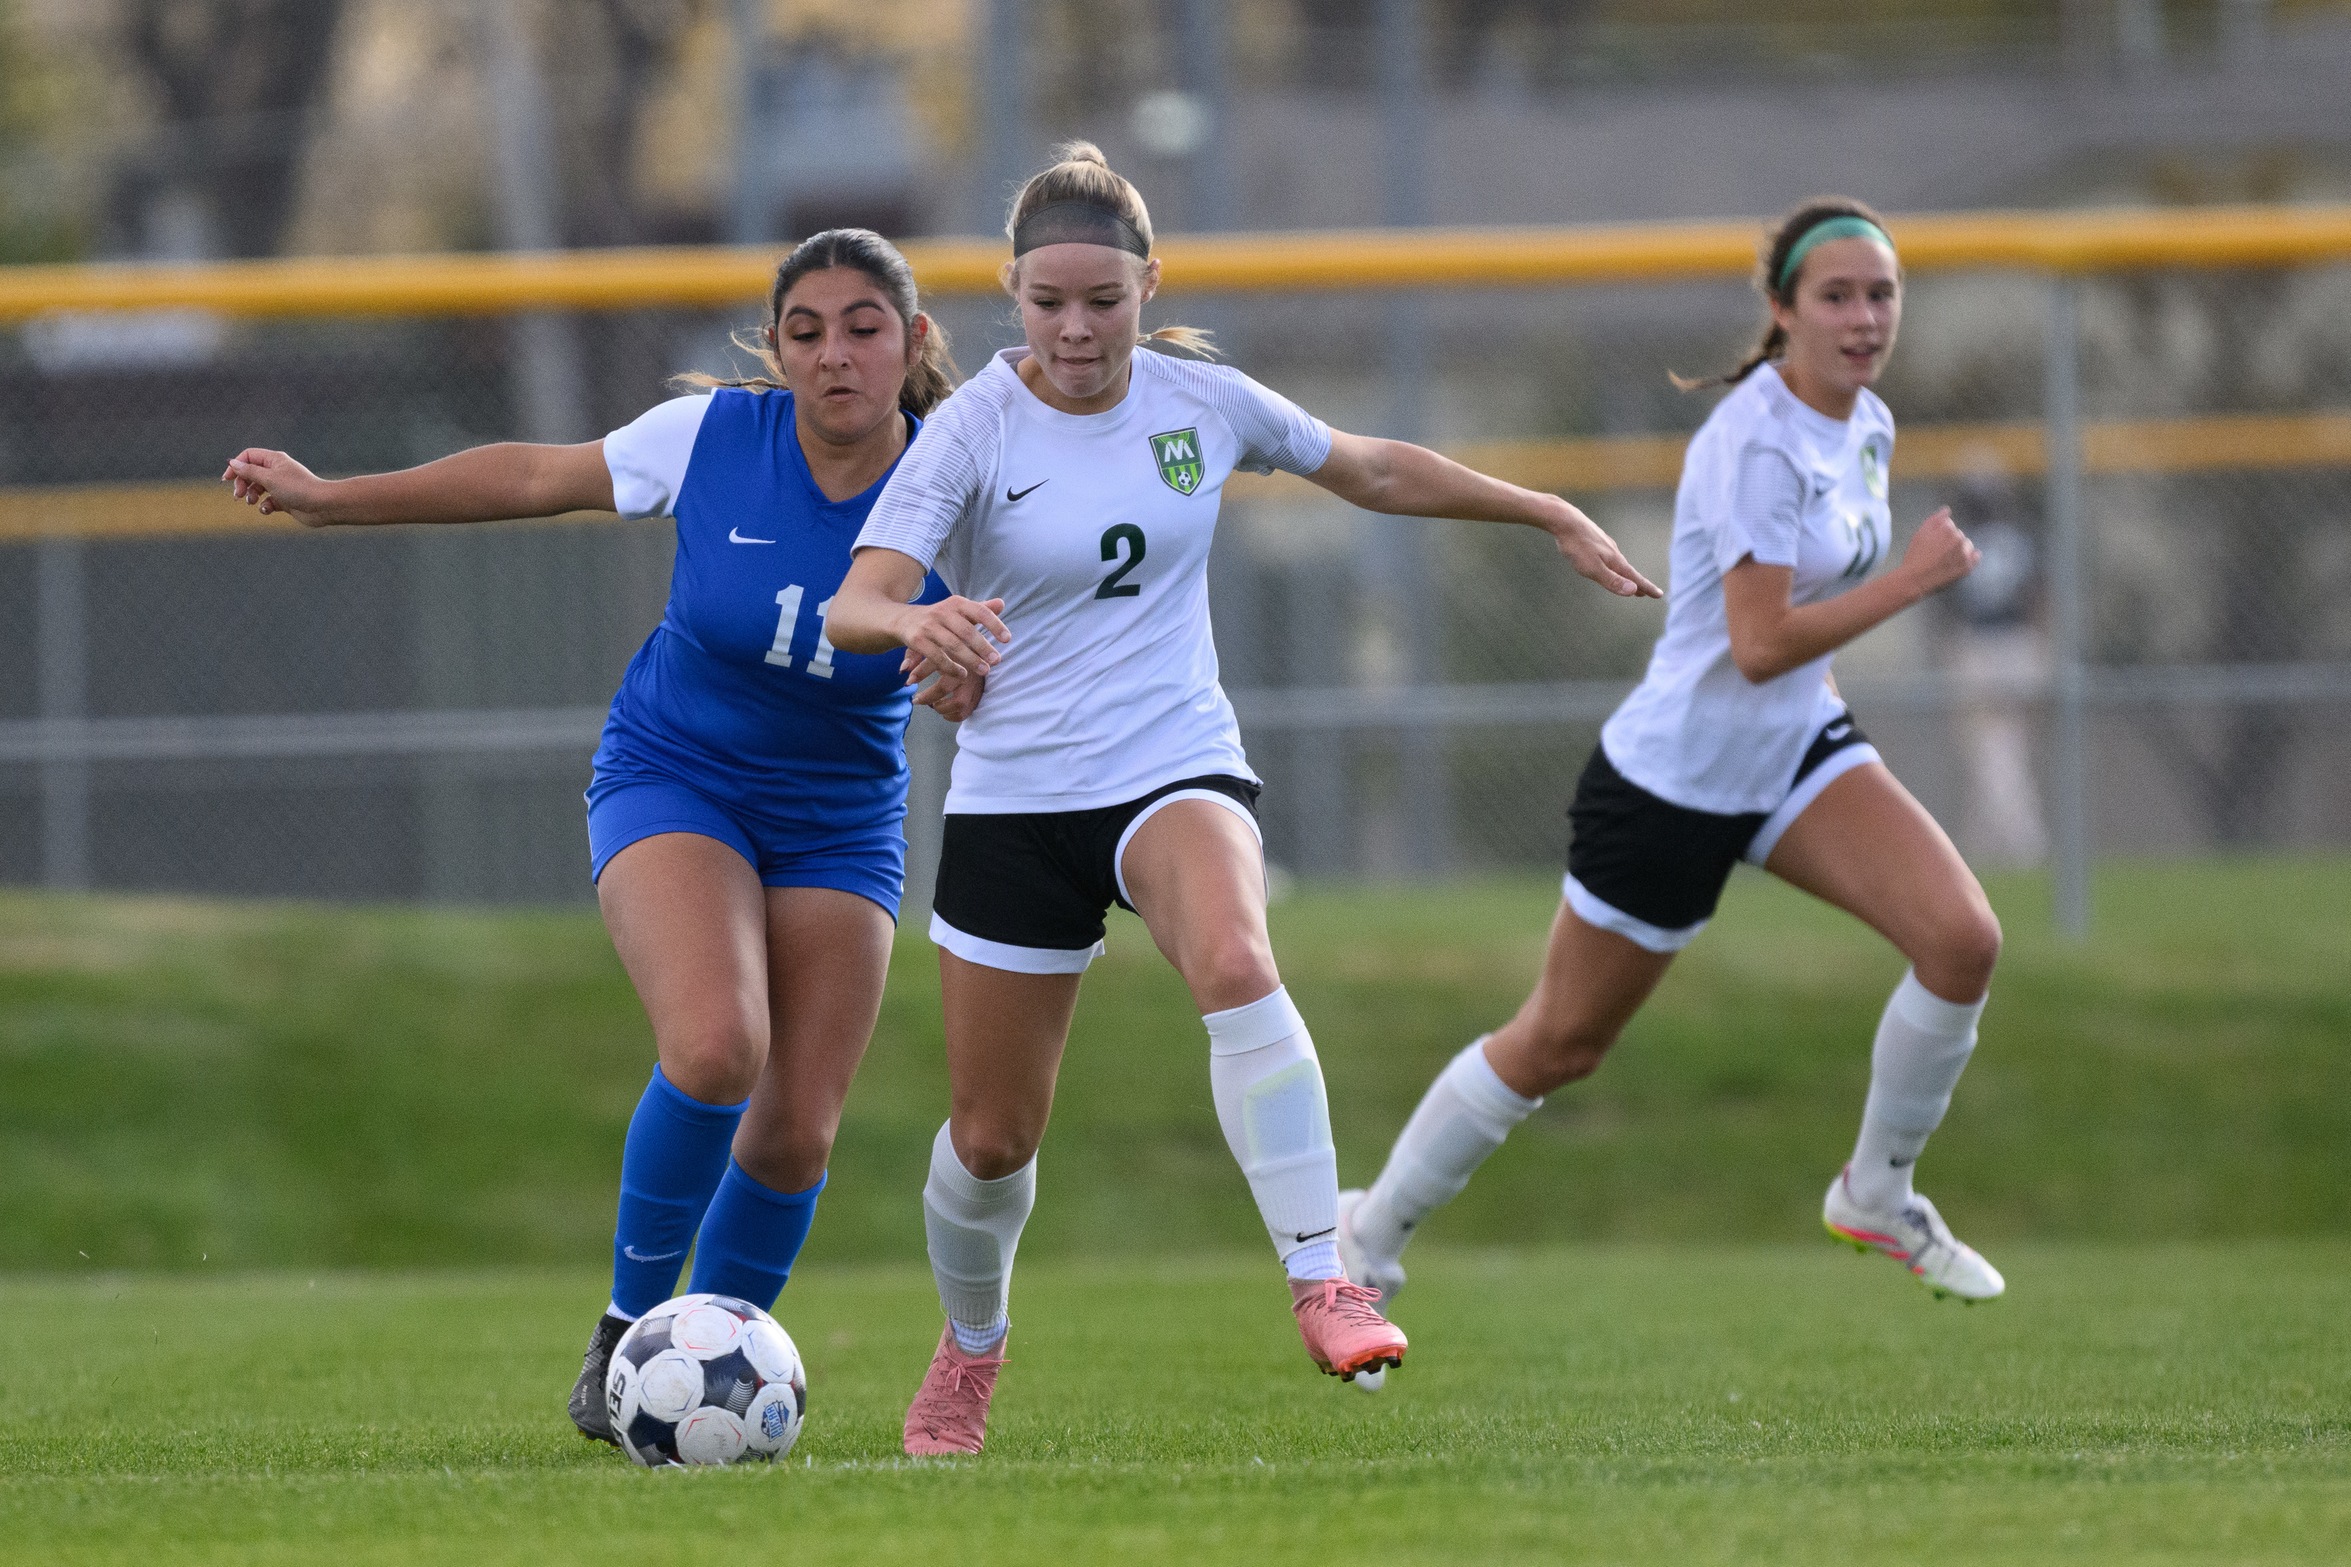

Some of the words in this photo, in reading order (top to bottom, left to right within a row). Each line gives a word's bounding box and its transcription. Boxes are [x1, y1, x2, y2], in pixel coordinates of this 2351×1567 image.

[1164, 439, 1195, 463] M
[1094, 522, 1146, 600] 2
[764, 583, 835, 679] 11
